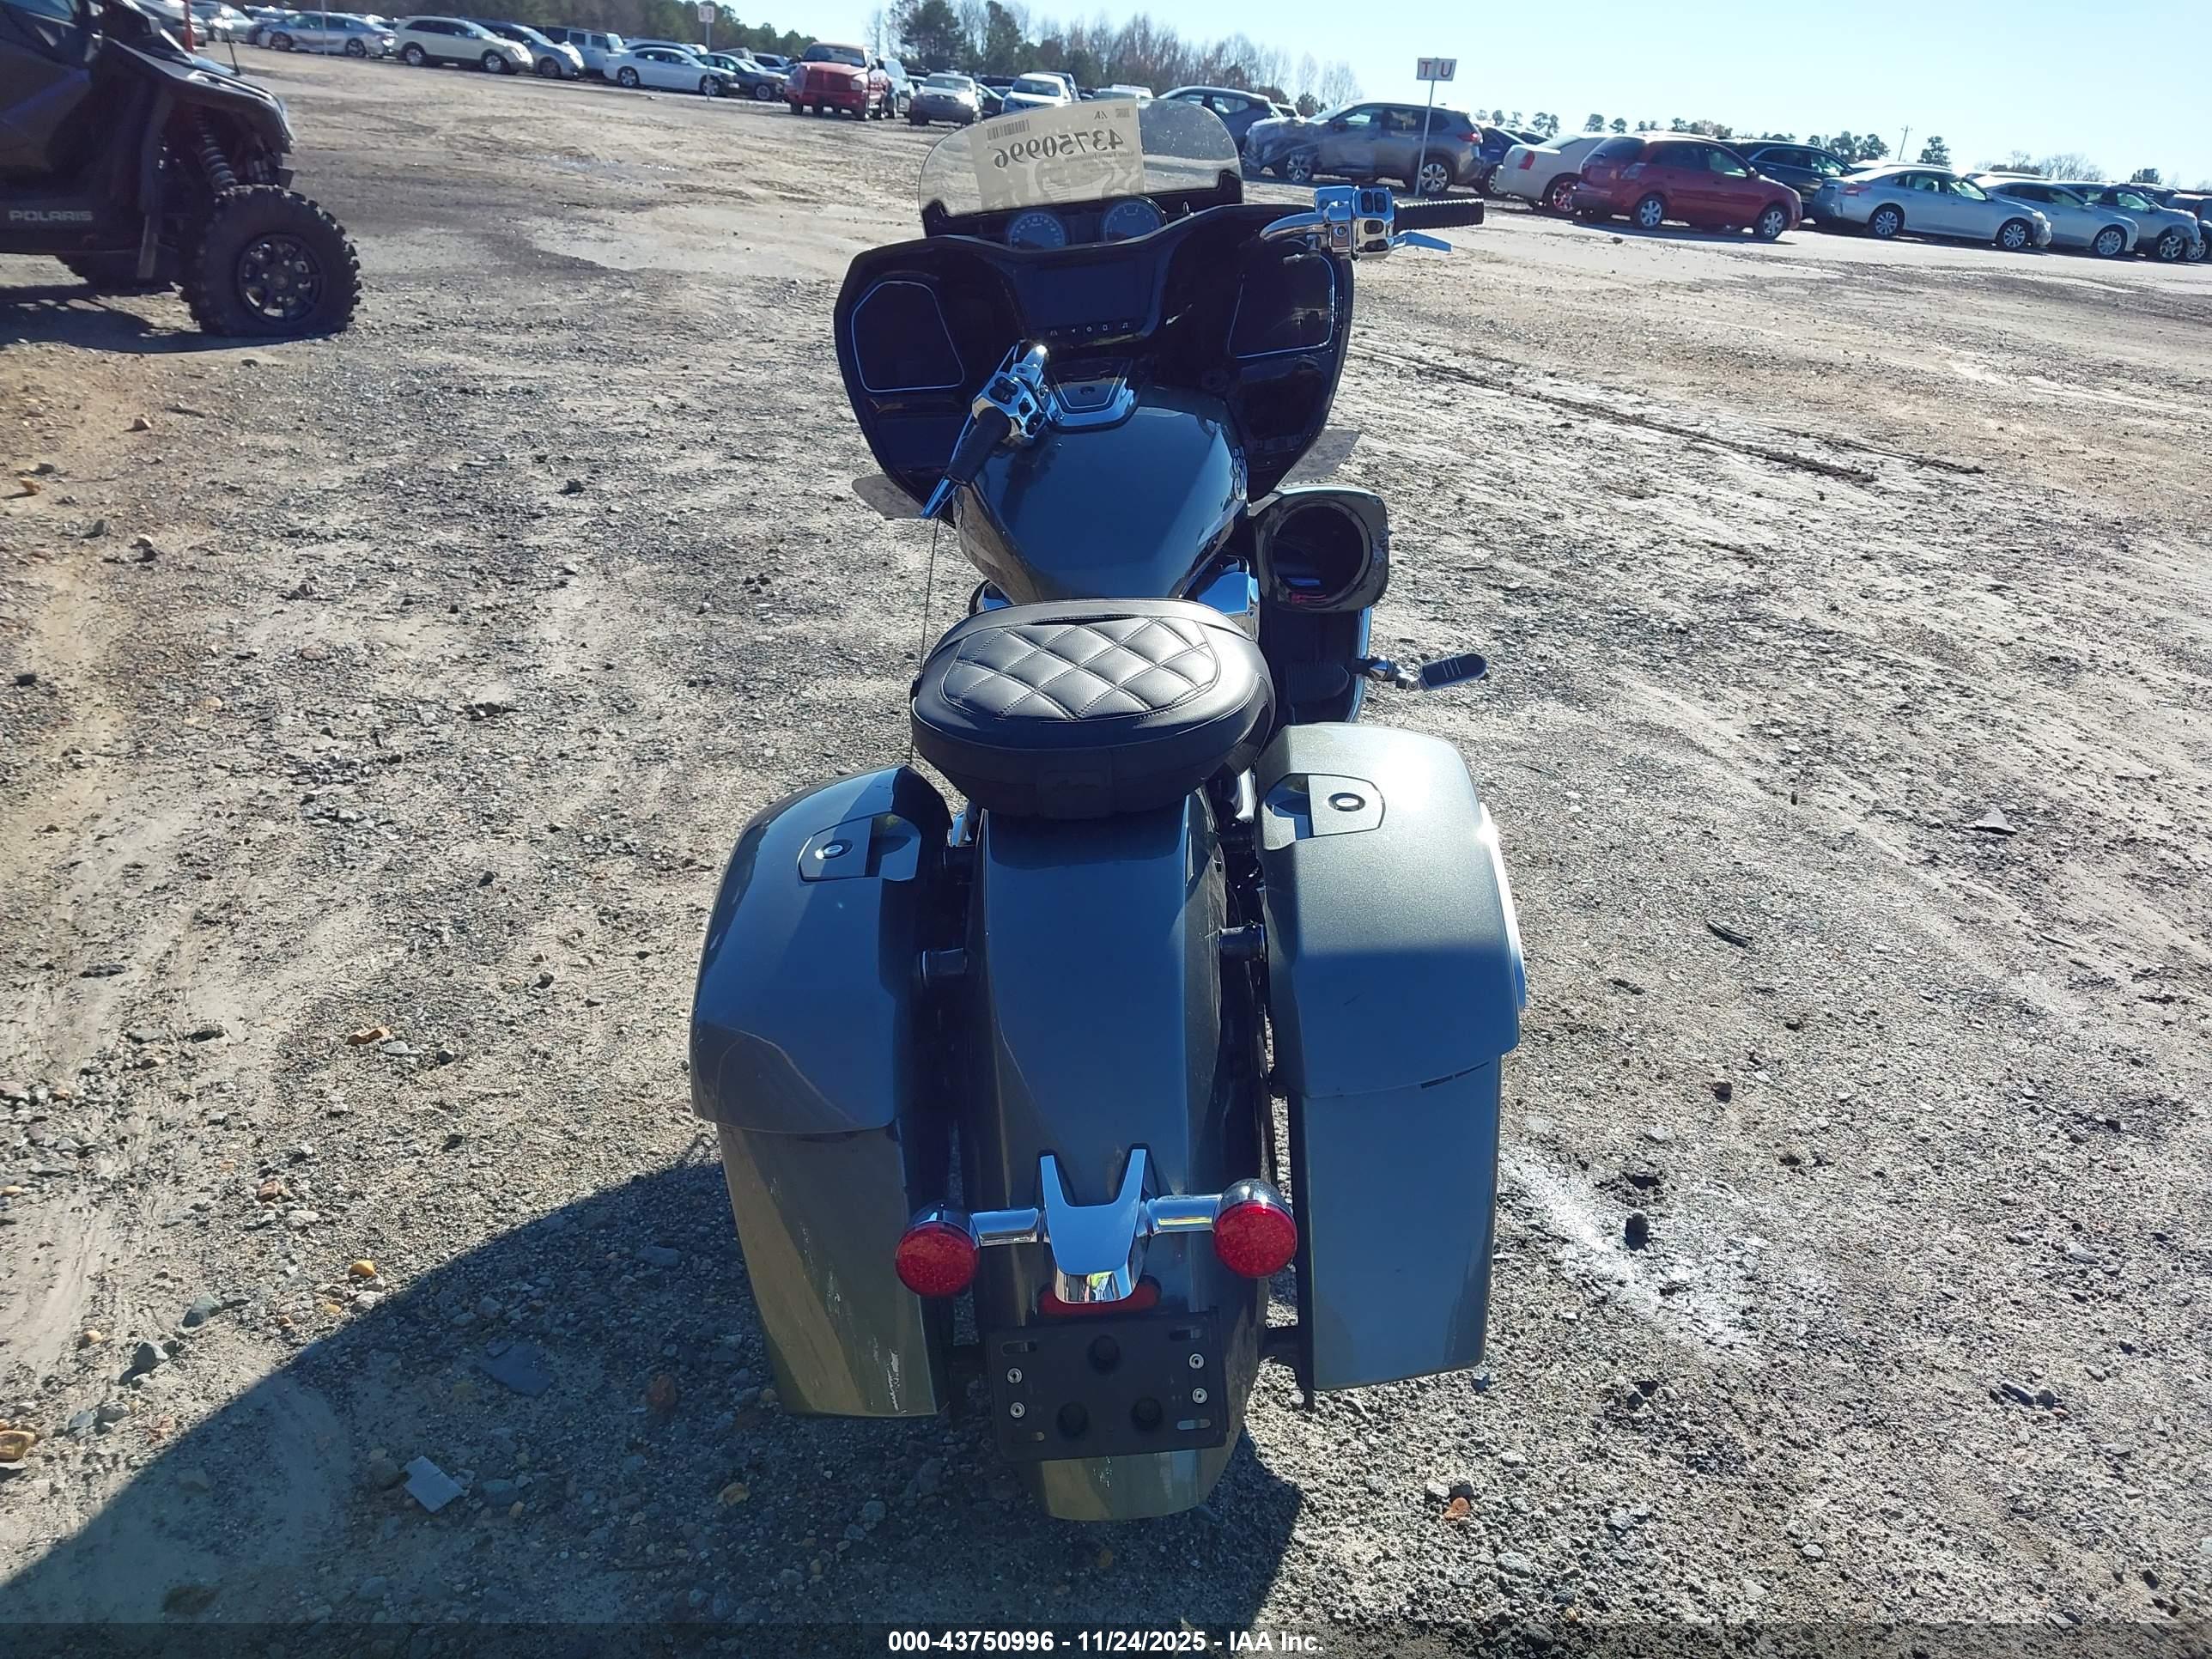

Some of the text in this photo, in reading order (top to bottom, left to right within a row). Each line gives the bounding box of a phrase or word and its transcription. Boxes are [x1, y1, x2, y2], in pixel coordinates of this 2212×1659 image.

[1421, 61, 1453, 77] T U
[9, 210, 94, 222] POLARIS
